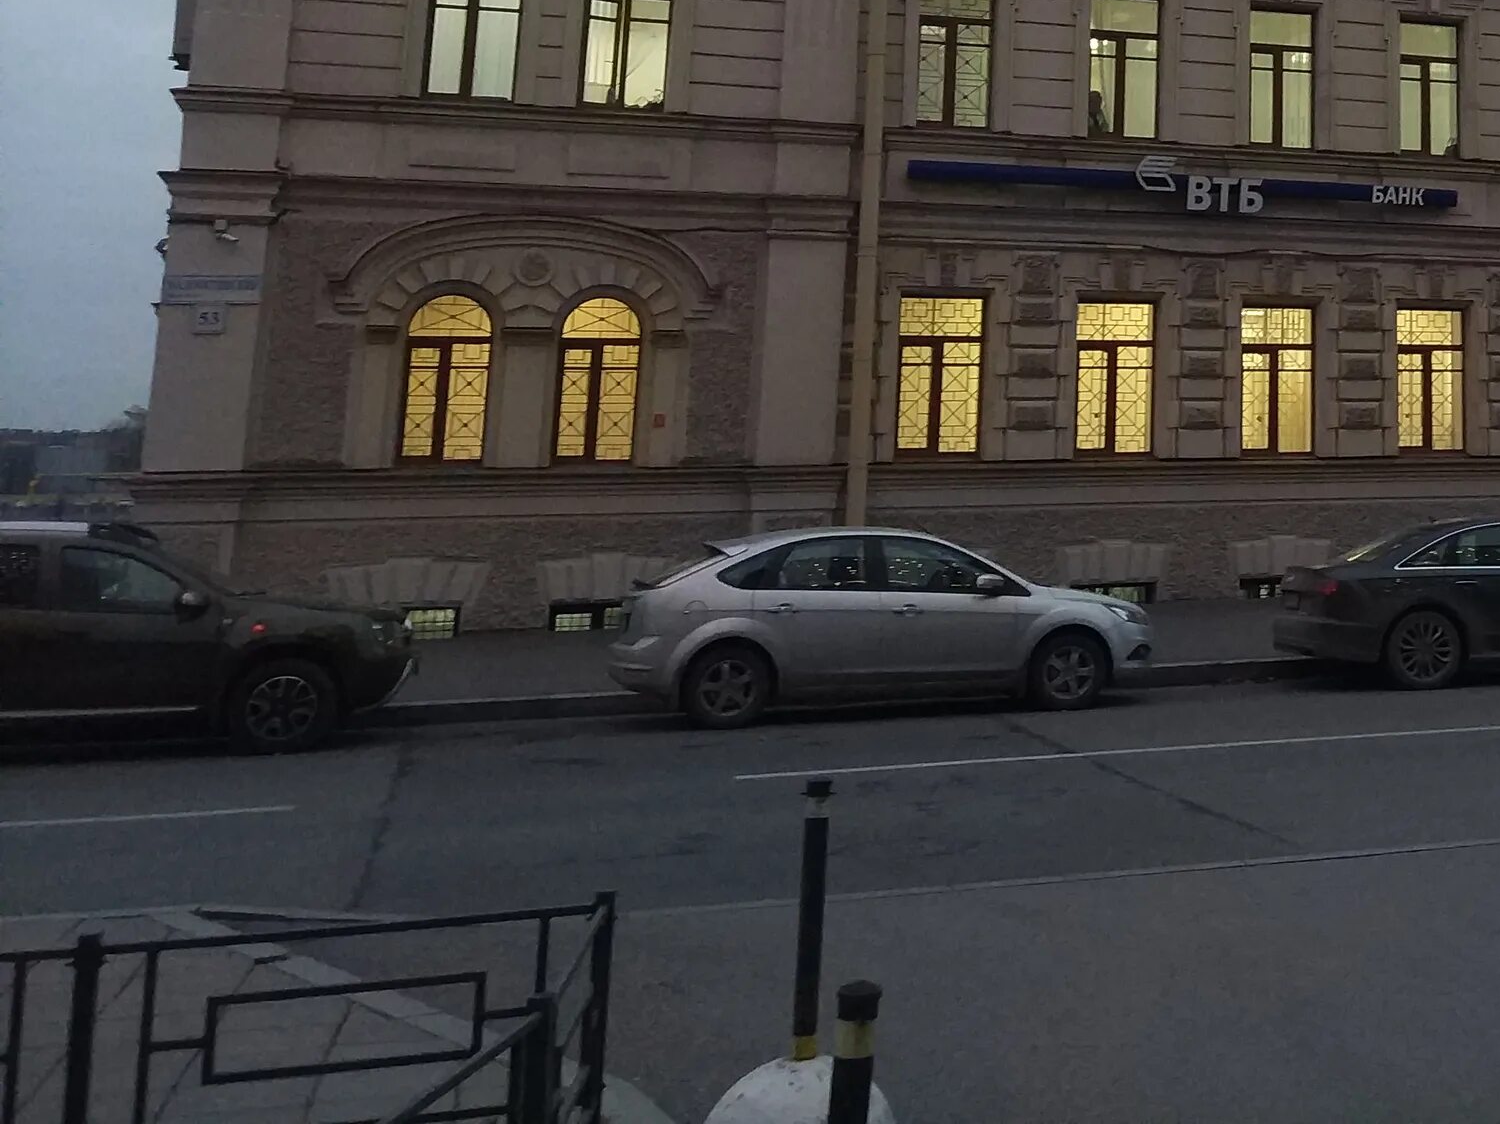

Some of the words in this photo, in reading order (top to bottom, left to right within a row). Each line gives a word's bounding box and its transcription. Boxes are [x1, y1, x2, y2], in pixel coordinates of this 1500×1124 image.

[1187, 176, 1264, 213] ВТБ
[1371, 185, 1425, 206] БАНК
[198, 311, 220, 326] 53
